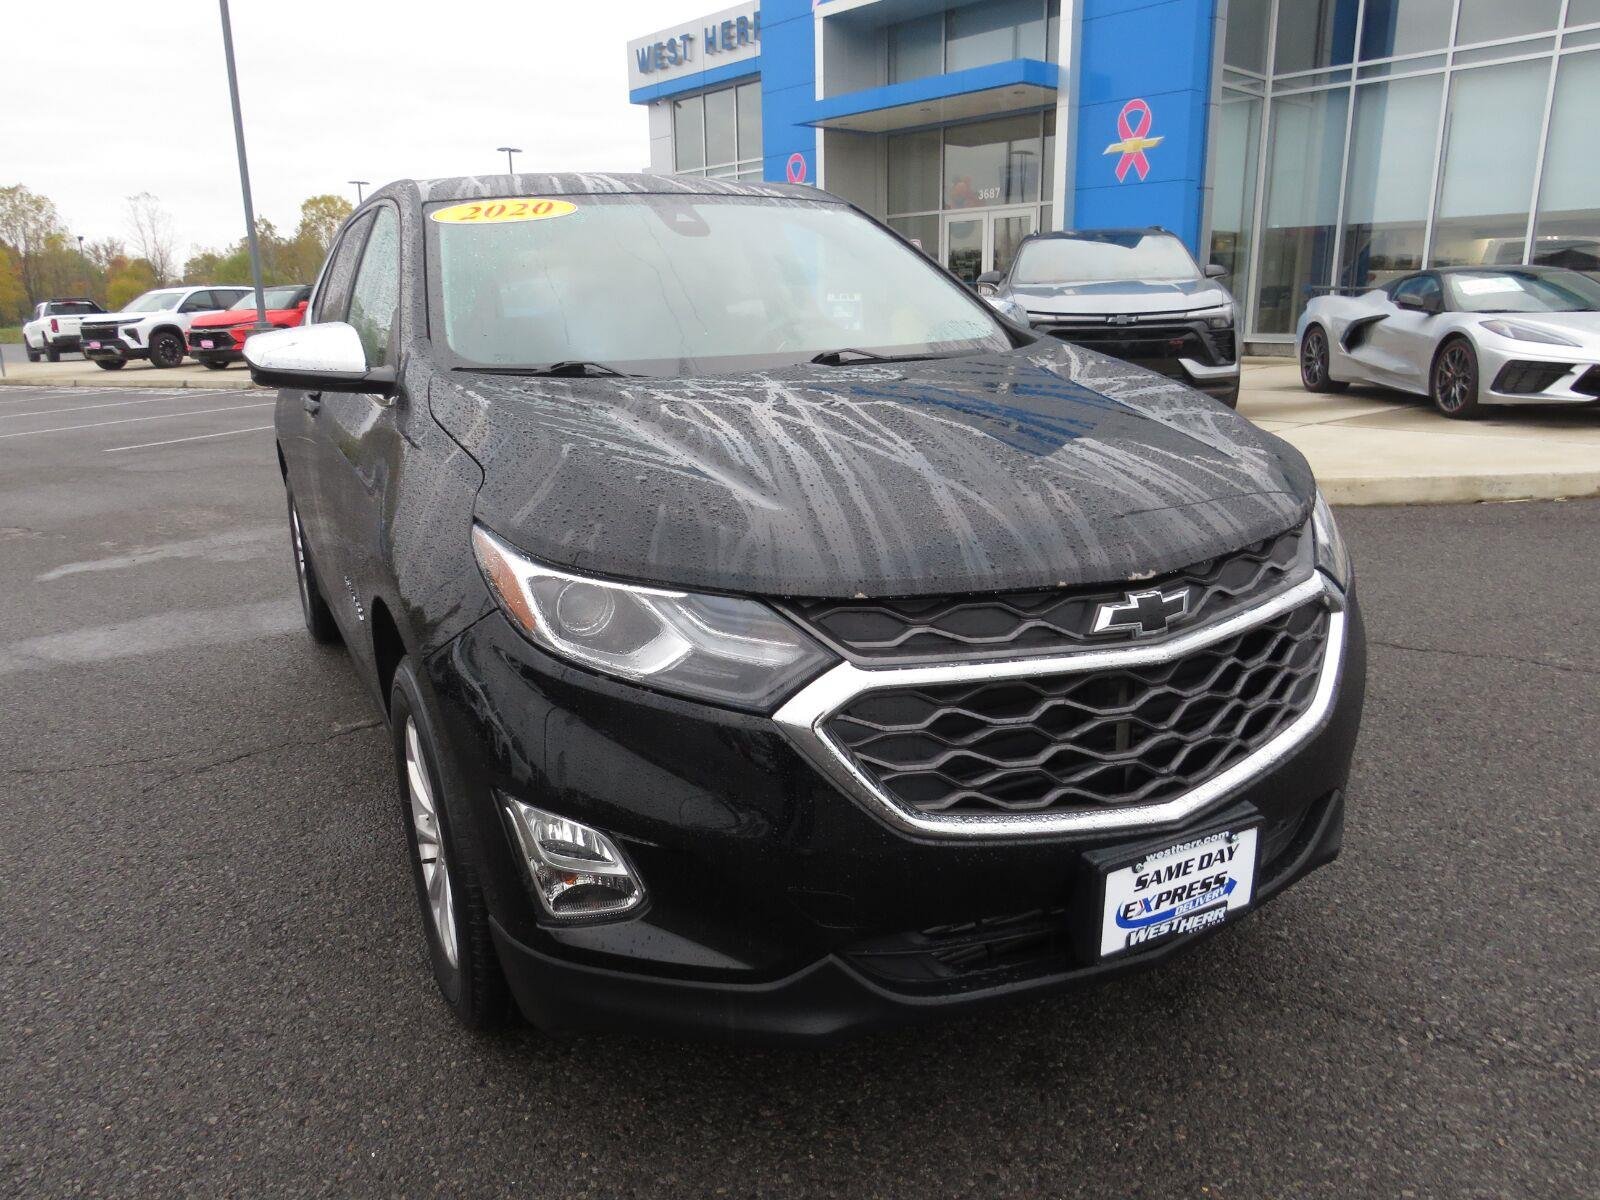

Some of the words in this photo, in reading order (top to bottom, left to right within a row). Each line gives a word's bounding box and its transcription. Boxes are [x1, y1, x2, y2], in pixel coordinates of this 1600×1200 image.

[636, 33, 693, 74] WEST
[978, 187, 1001, 200] 3687
[459, 201, 554, 221] 2020
[1145, 830, 1230, 861] westherr.com
[1133, 858, 1196, 893] SAME
[1197, 843, 1241, 871] DAY
[1123, 870, 1228, 920] EXPRESS
[1174, 888, 1226, 916] DELIVERY
